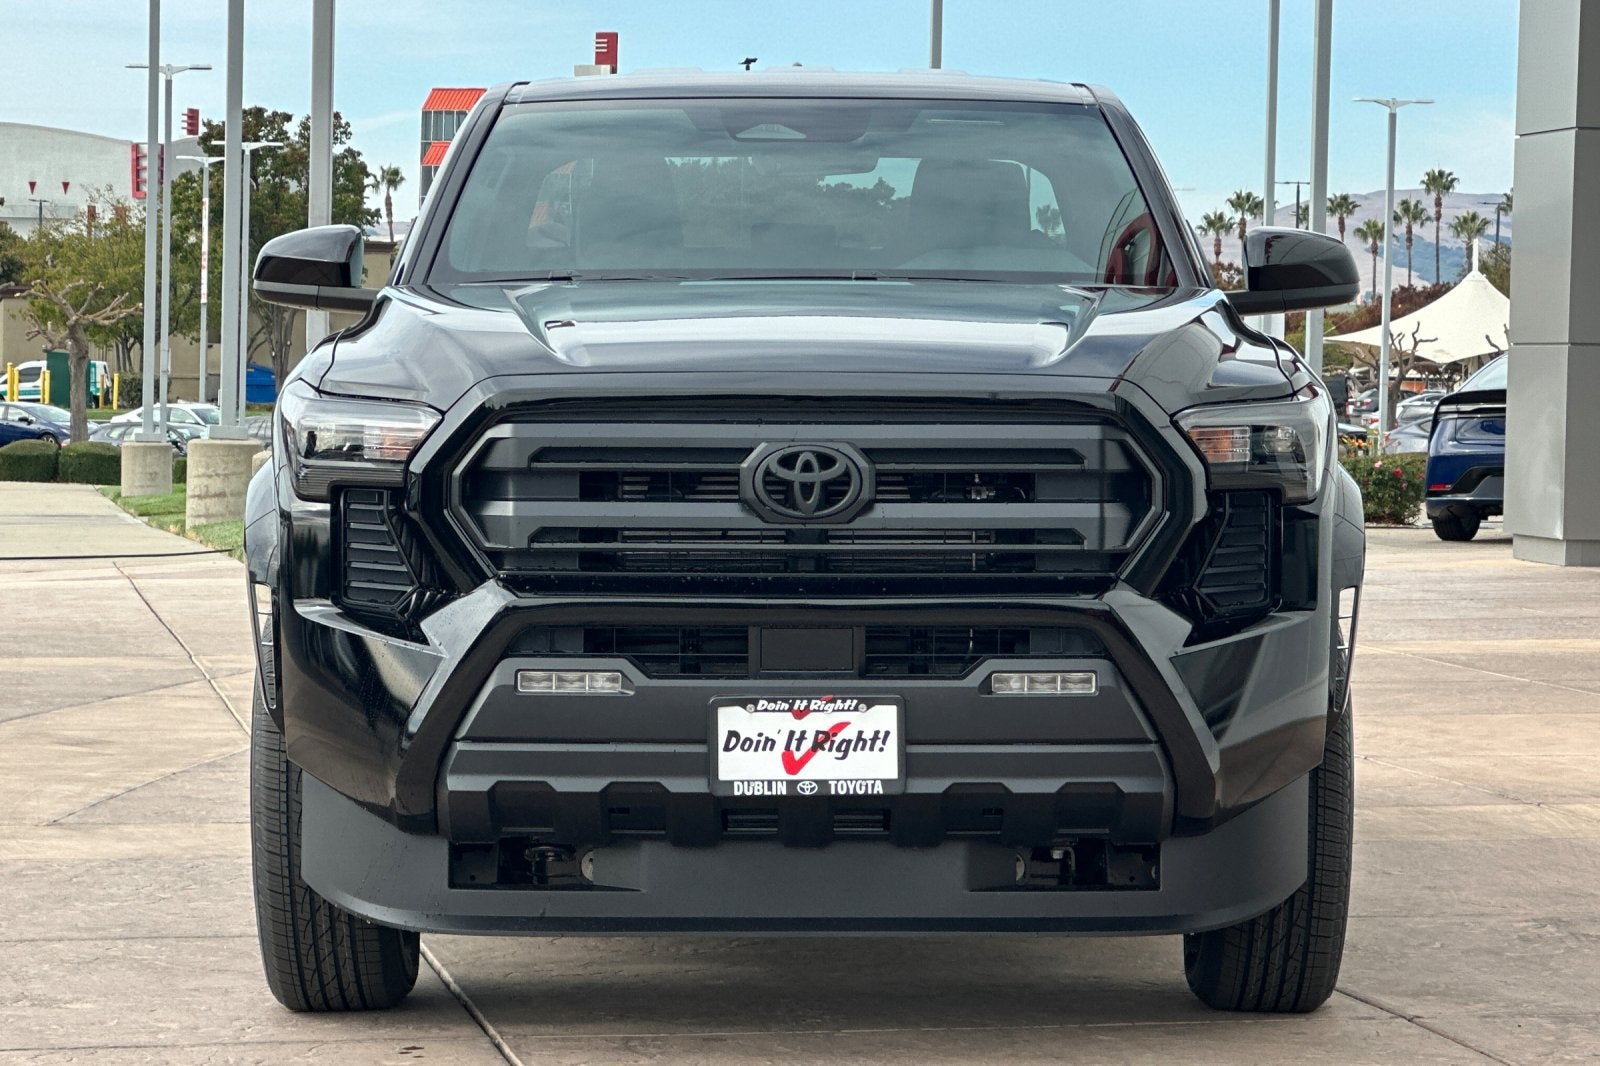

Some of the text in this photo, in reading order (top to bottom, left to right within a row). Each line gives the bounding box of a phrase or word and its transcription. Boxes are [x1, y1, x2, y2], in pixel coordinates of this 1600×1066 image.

[757, 699, 858, 713] Doin' It Right!
[723, 729, 891, 760] Doin' It Right!
[733, 780, 883, 796] DUBLIN TOYOTA
